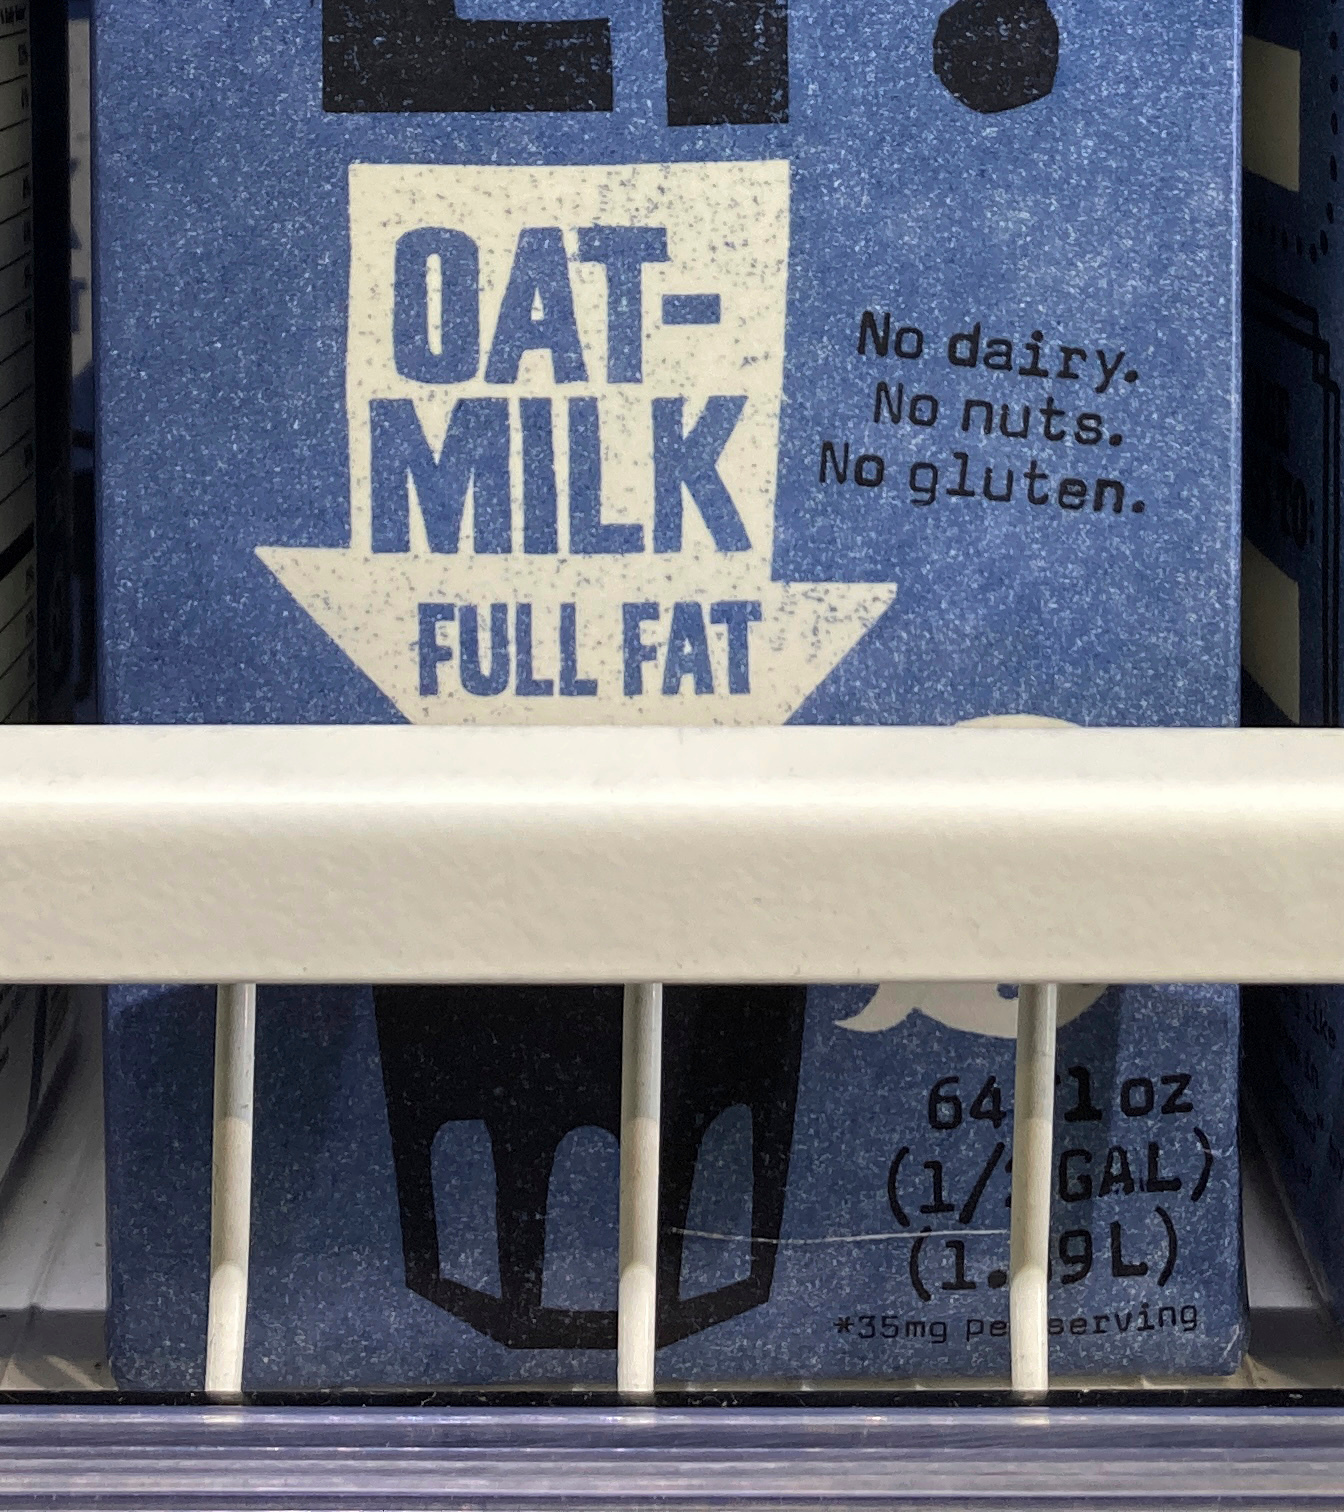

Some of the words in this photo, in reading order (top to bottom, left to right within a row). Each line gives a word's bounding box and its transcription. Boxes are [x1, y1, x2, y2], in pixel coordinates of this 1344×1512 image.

[393, 225, 722, 384] OAT-
[857, 310, 923, 359] No
[947, 322, 1139, 394] dairy.
[873, 382, 939, 426] No
[961, 396, 1123, 447] nuts.
[369, 394, 752, 554] MILK
[819, 440, 885, 487] No
[909, 451, 1145, 514] gluten.
[418, 601, 597, 697] FULL
[622, 600, 762, 697] FAT
[928, 1076, 1007, 1130] 64
[1120, 1073, 1194, 1117] oz
[1058, 1127, 1213, 1203] GAL)
[965, 1317, 1010, 1341] pe
[1047, 1302, 1198, 1339] serving
